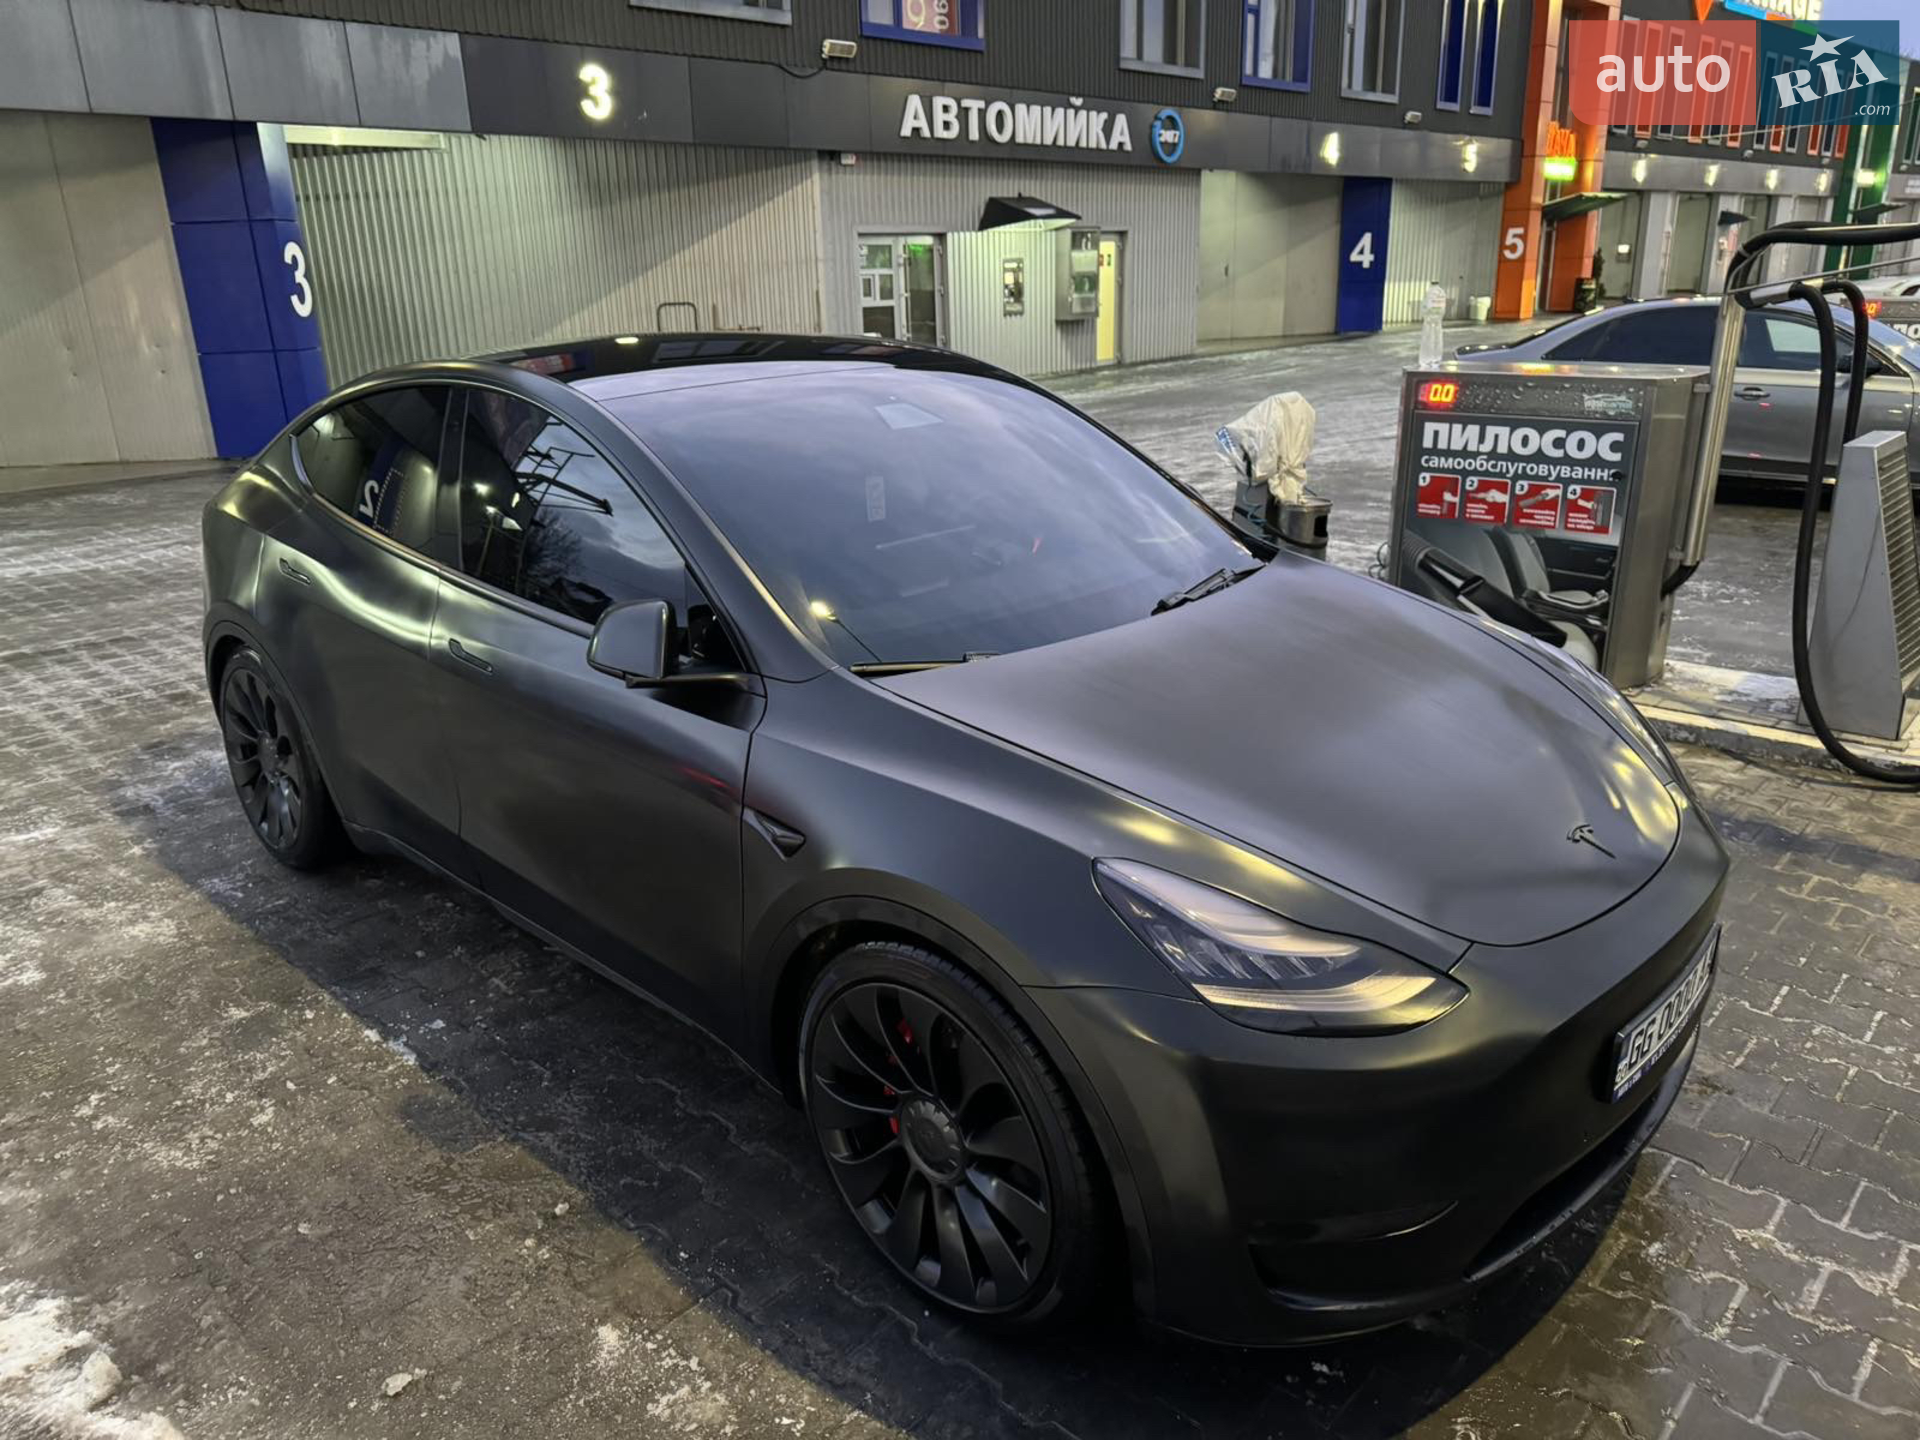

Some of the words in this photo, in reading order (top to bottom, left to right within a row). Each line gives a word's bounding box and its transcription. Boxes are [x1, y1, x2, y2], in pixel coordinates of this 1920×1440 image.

[579, 63, 613, 120] 3
[900, 94, 1132, 151] АВТОМИЙКА
[1350, 232, 1374, 268] 4
[1503, 227, 1525, 259] 5
[284, 242, 313, 317] 3
[1422, 422, 1625, 462] ПИЛОСОС
